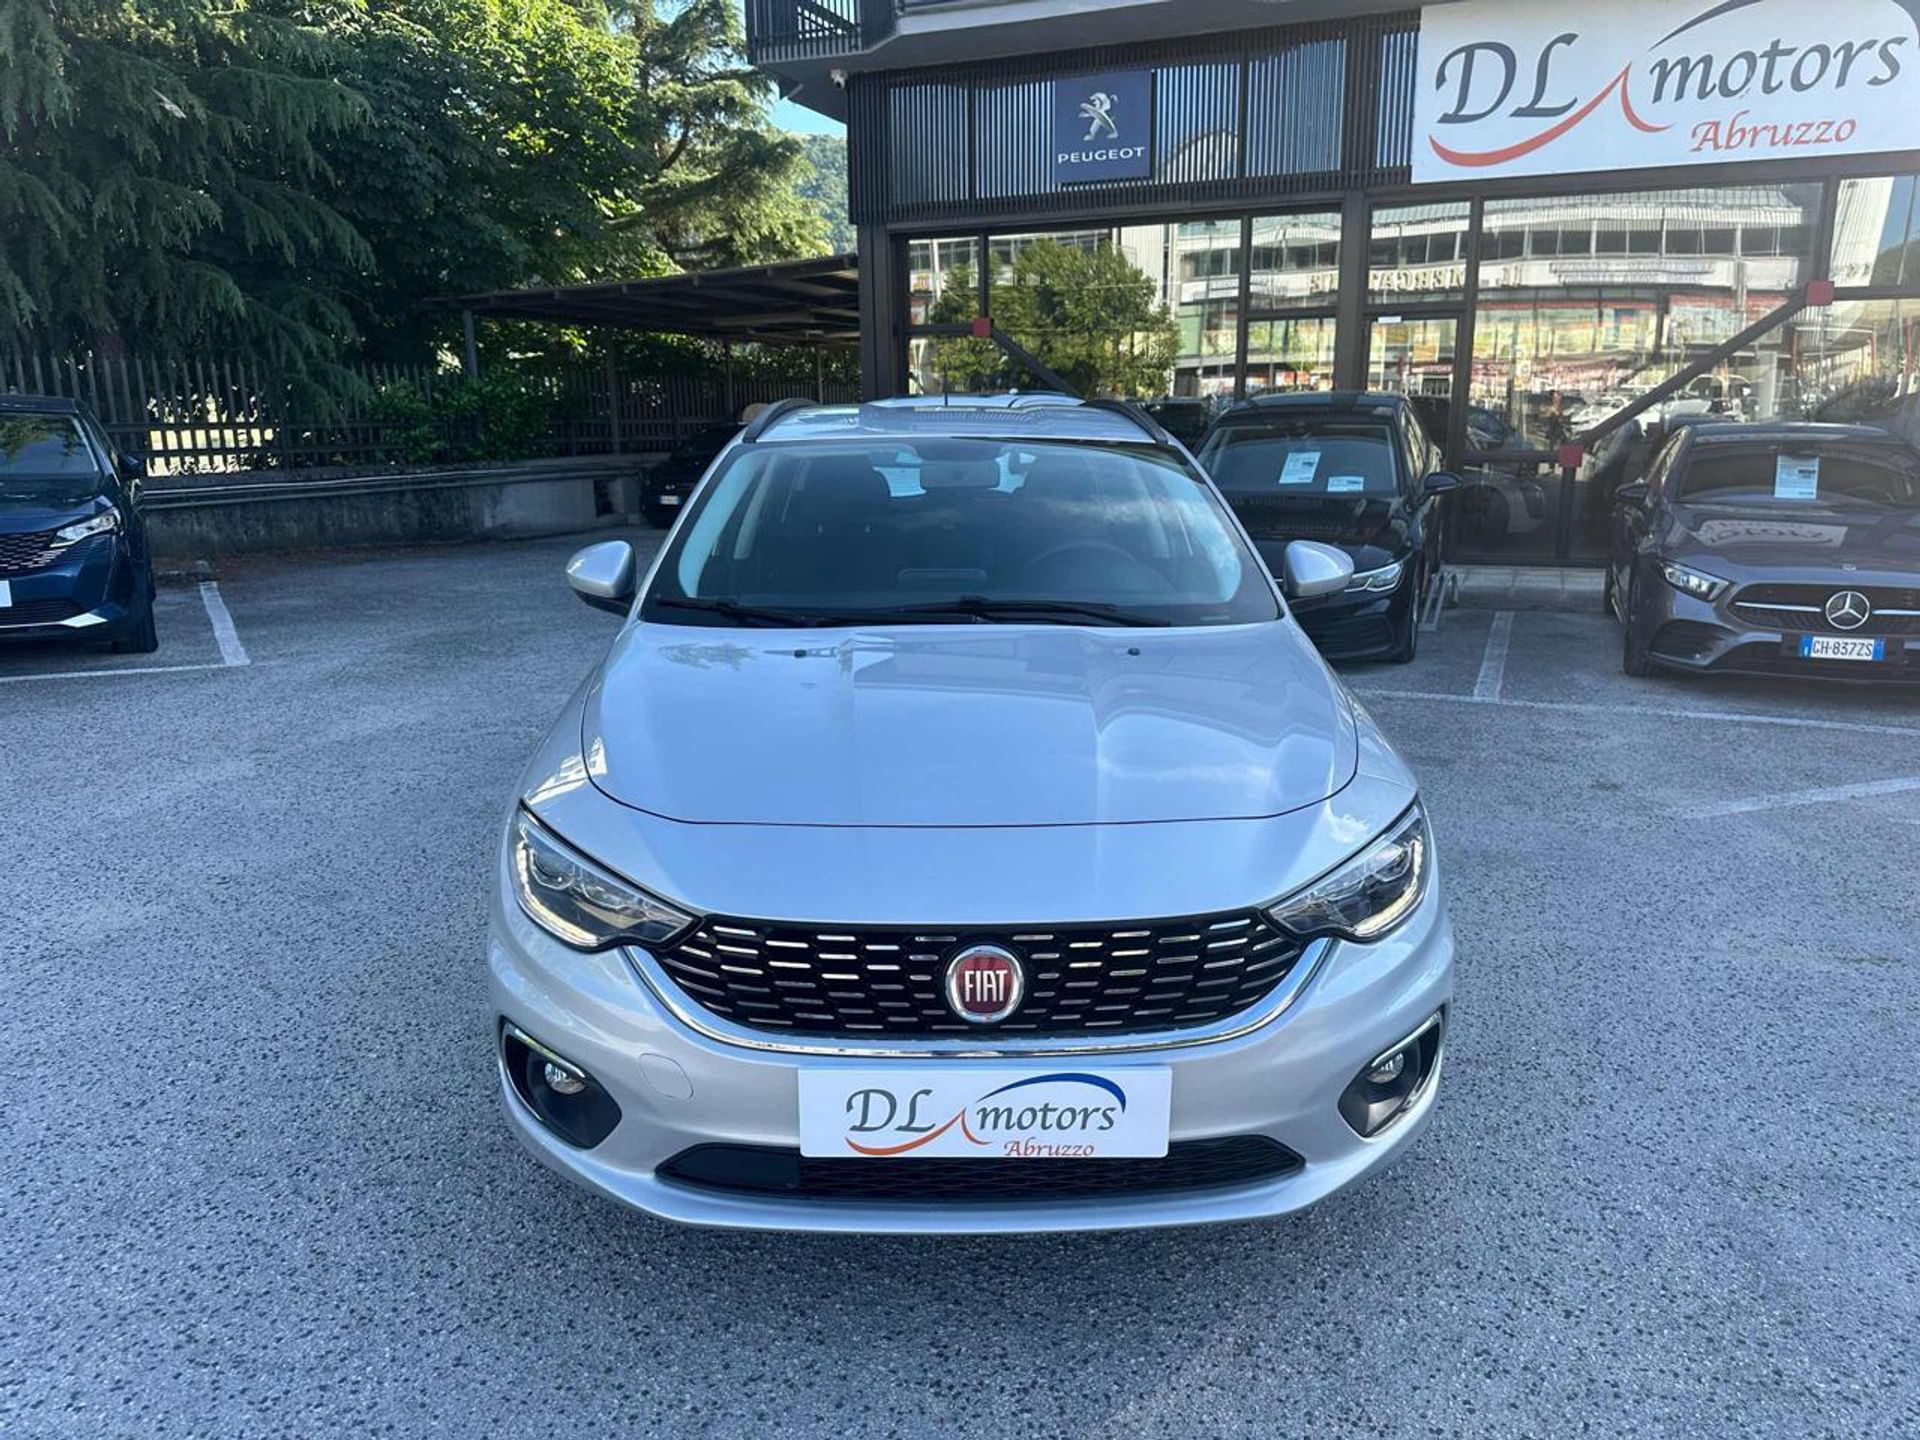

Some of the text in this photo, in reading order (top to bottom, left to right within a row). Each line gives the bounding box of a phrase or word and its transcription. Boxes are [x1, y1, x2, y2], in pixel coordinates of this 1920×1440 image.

[1435, 33, 1909, 124] DL motors
[1690, 110, 1857, 153] Abruzzo
[1057, 146, 1145, 164] PEUGEOT
[964, 969, 1008, 1003] FIAT
[846, 1088, 1117, 1133] DL motors
[1003, 1136, 1095, 1157] Abruzzo
